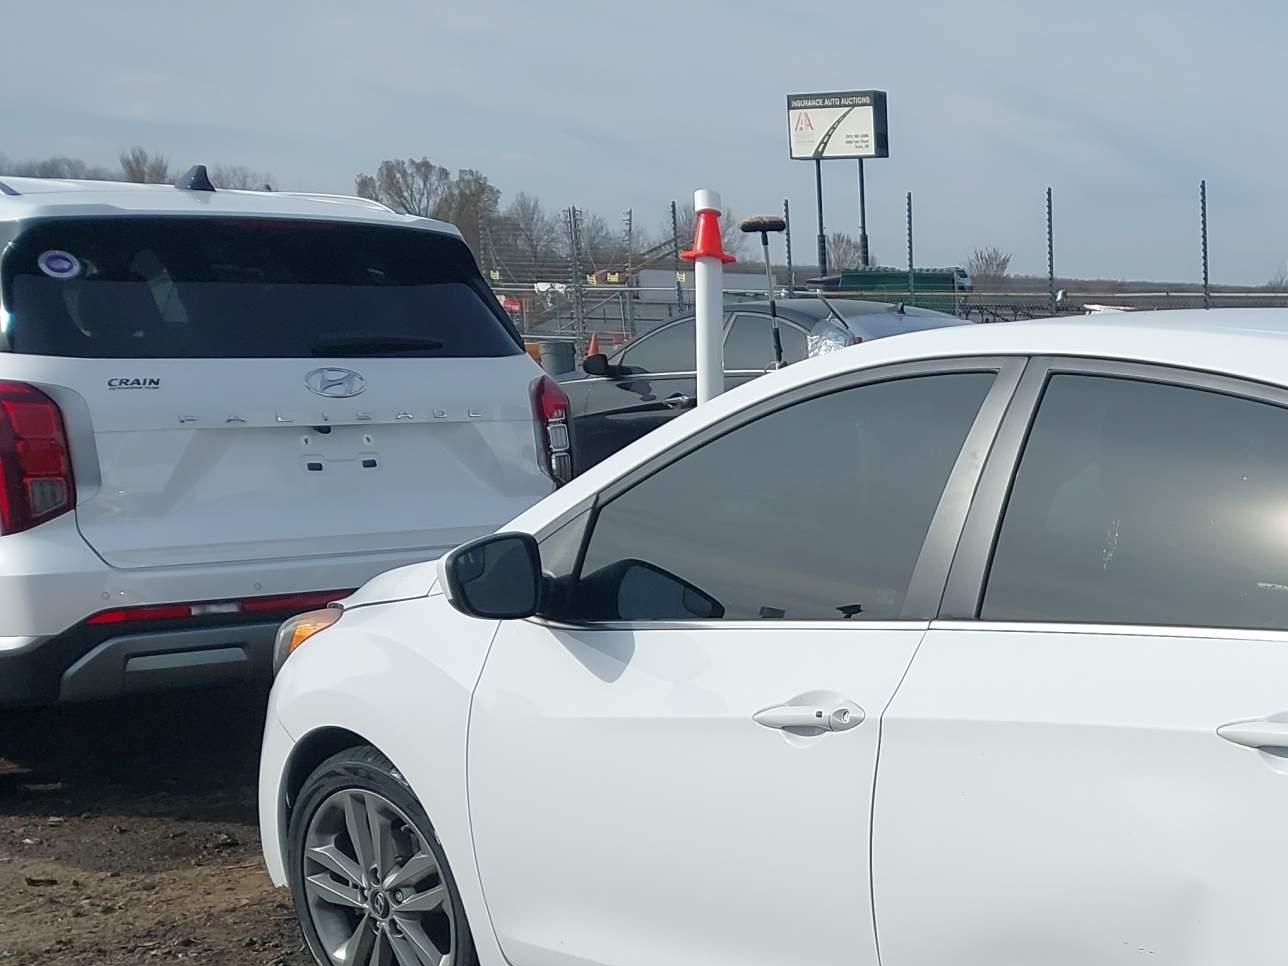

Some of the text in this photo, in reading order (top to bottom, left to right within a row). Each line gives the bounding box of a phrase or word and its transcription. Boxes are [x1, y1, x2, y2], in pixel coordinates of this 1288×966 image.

[791, 95, 871, 107] INSURANCE AUTO AUCTIONS
[107, 378, 160, 387] CRAIN
